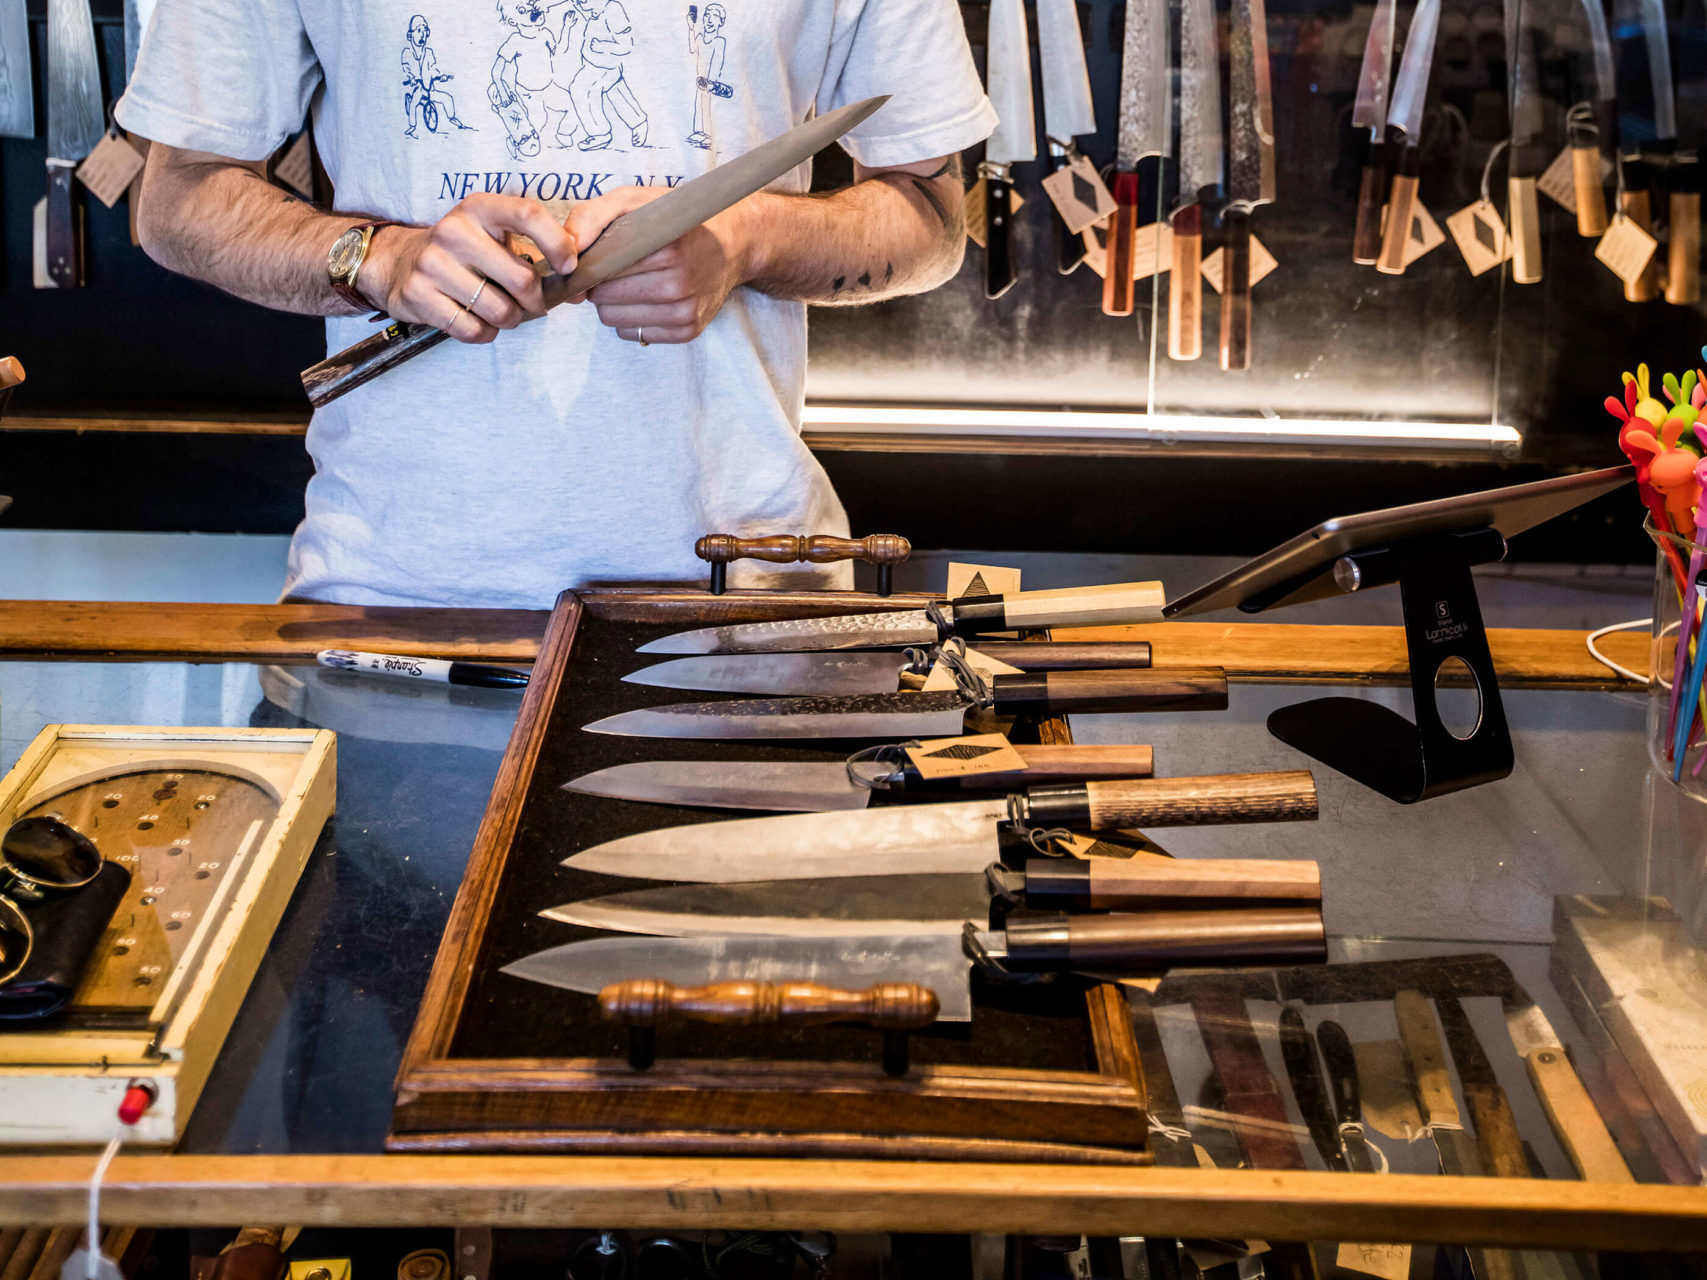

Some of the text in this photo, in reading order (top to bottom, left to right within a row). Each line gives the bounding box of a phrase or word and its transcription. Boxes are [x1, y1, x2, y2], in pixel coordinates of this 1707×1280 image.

[438, 172, 512, 201] NEW
[518, 172, 614, 201] YORK
[384, 658, 427, 677] Sharpie
[143, 886, 166, 894] 40
